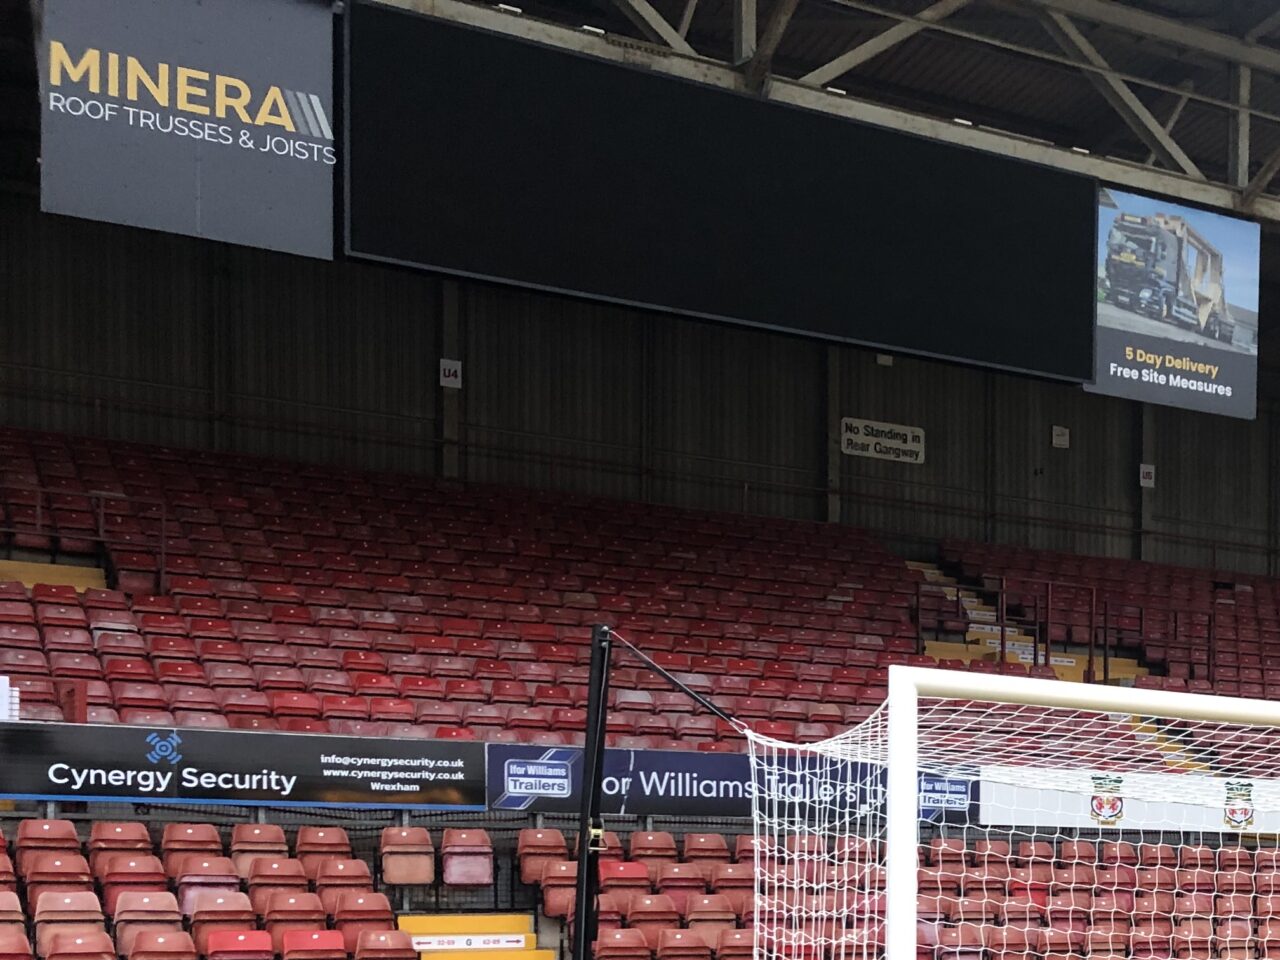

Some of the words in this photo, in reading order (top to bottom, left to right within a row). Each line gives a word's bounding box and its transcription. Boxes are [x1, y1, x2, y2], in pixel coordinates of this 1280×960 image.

[50, 40, 296, 132] MINERA
[49, 92, 118, 121] ROOF
[124, 105, 233, 145] TRUSSES
[238, 129, 255, 149] &
[259, 134, 337, 165] JOISTS
[1126, 346, 1134, 360] 5
[1136, 349, 1163, 369] Day
[1165, 355, 1219, 379] Delivery
[1109, 362, 1139, 380] Free
[1141, 368, 1167, 385] Site
[1169, 374, 1233, 397] Measures
[844, 422, 860, 435] No
[863, 424, 908, 444] Standing
[911, 430, 921, 444] in
[846, 438, 870, 452] Rear
[874, 441, 920, 461] Gangway
[320, 754, 464, 768] info@cynergysecurity.co.uk
[509, 764, 526, 775] Ifor
[527, 765, 567, 777] Williams
[48, 763, 173, 792] Cynergy
[181, 767, 298, 795] Security
[322, 769, 465, 780] www.cynergysecurity.co.uk
[509, 778, 566, 791] Trailers
[601, 776, 632, 795] or
[639, 771, 755, 798] Williams
[370, 782, 420, 791] Wrexham
[465, 938, 472, 947] G
